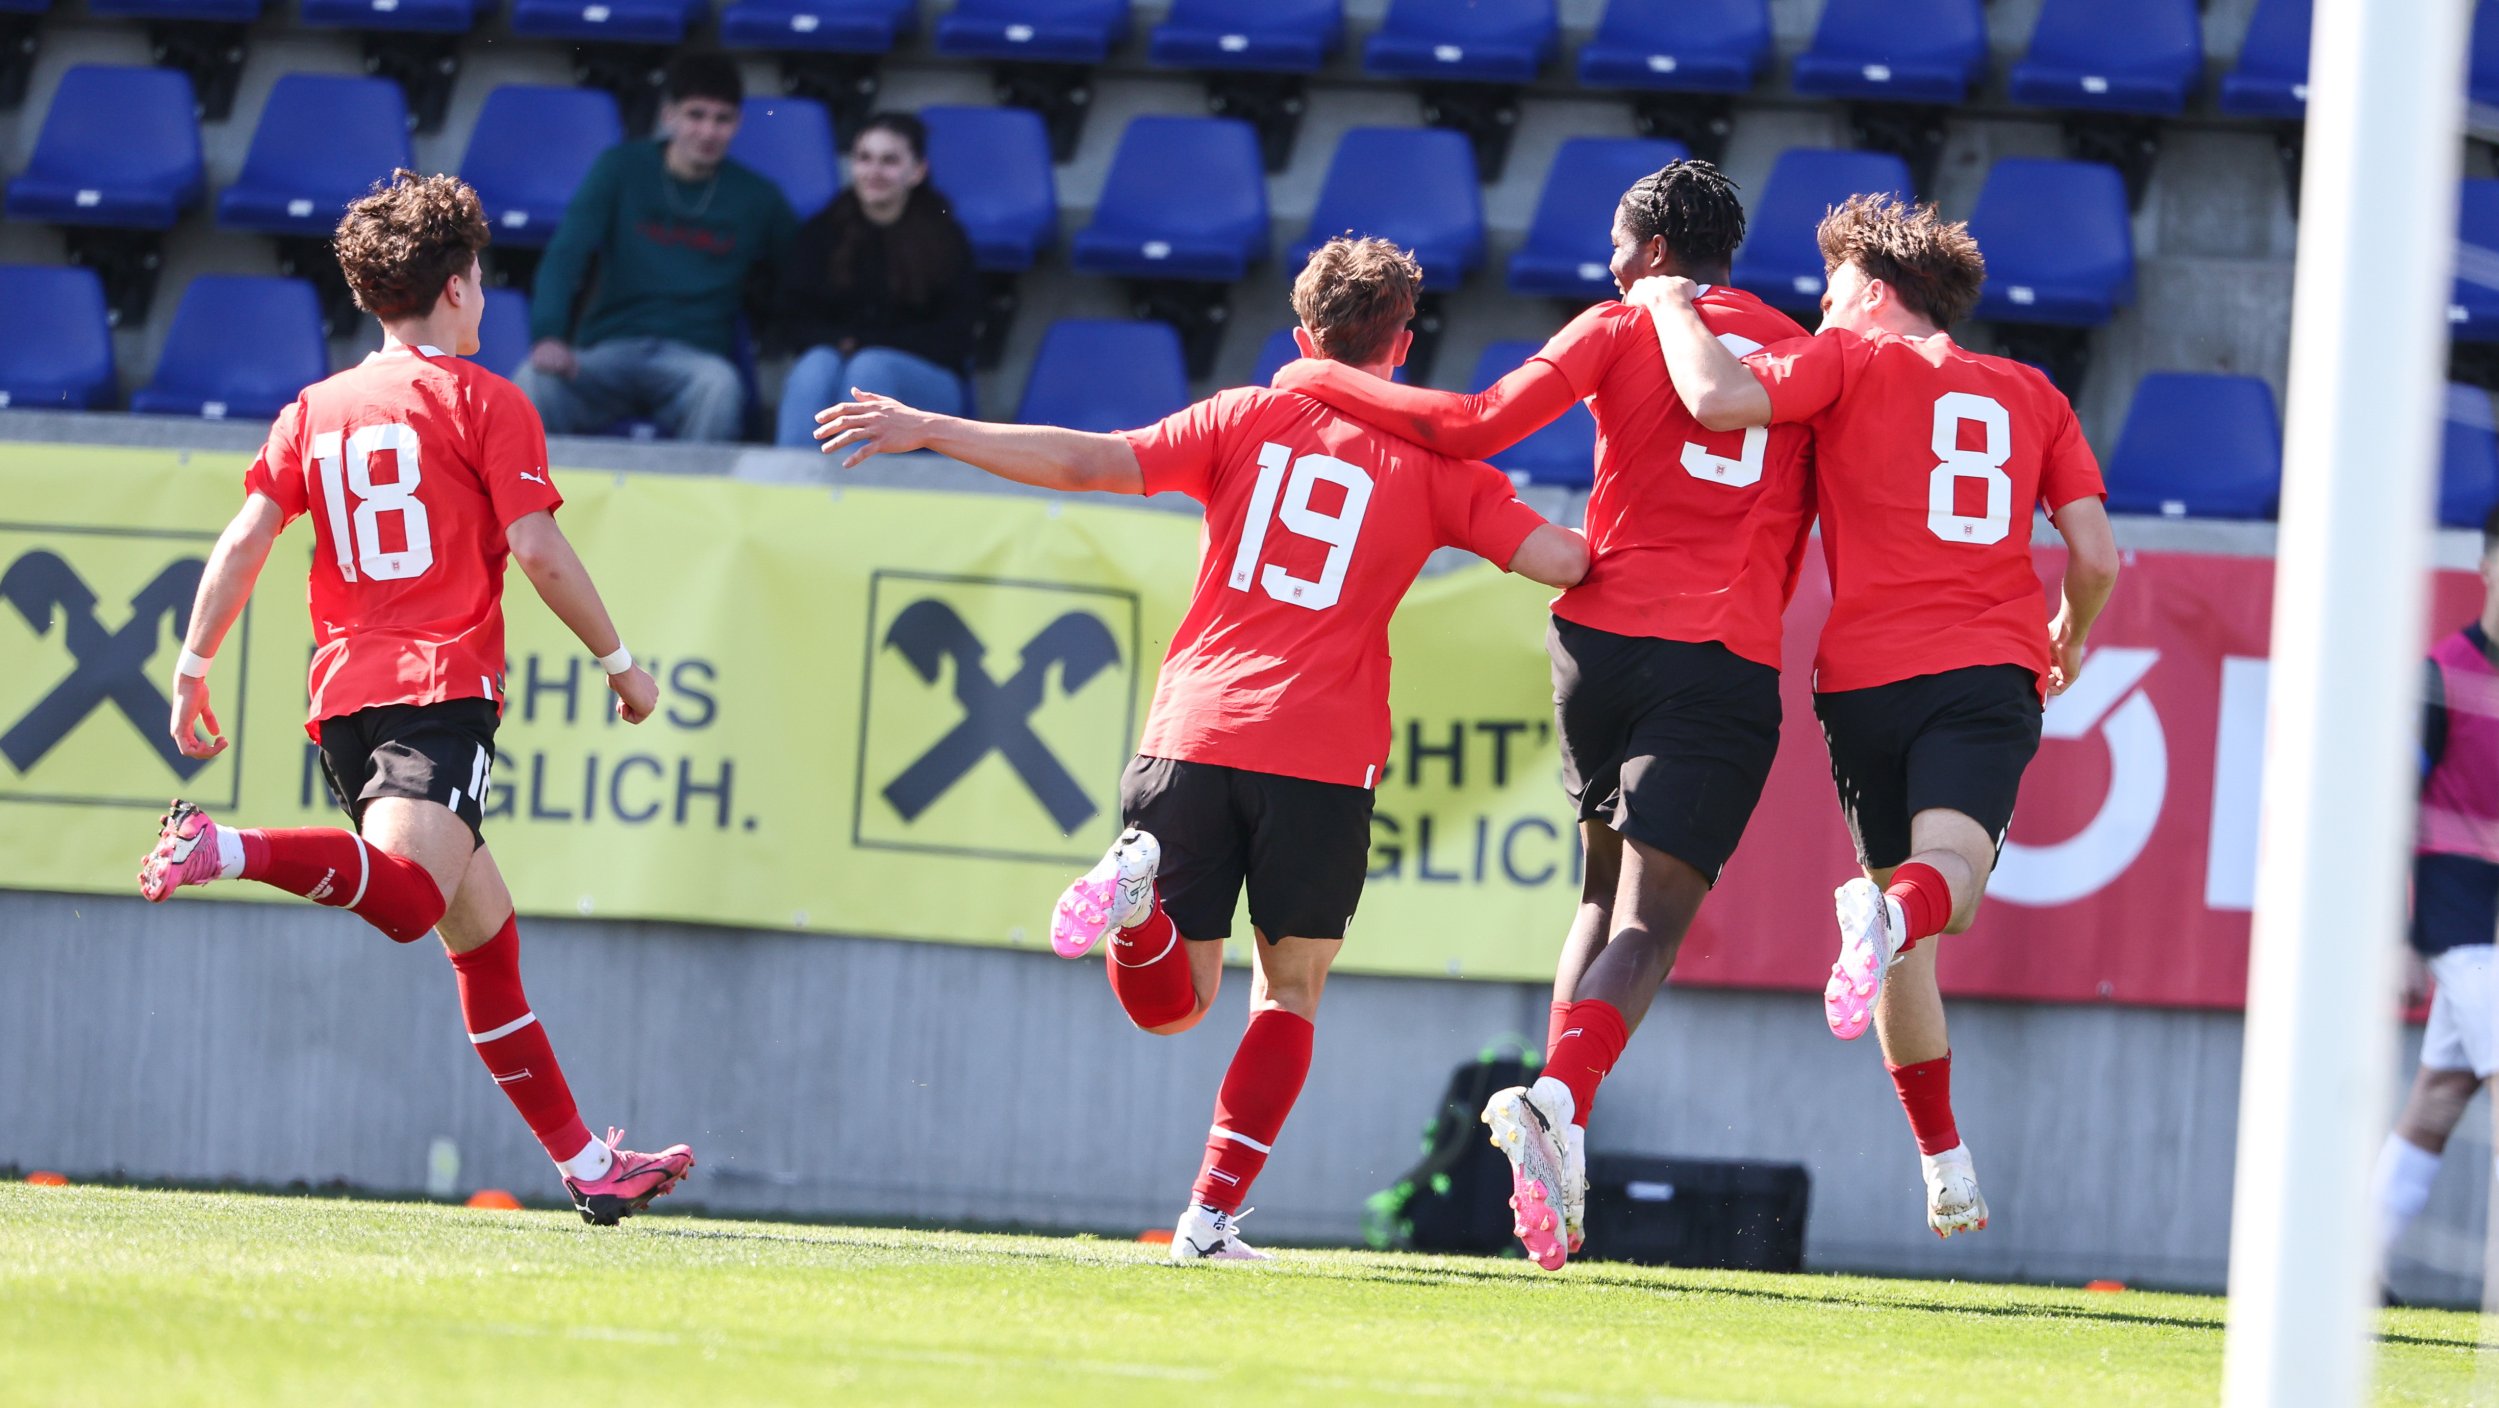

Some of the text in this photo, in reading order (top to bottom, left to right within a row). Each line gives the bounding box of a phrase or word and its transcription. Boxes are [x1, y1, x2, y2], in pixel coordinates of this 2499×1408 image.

[313, 423, 434, 583] 18
[1229, 442, 1375, 611] 19
[1928, 391, 2012, 545] 8
[302, 744, 761, 831] GLICH.
